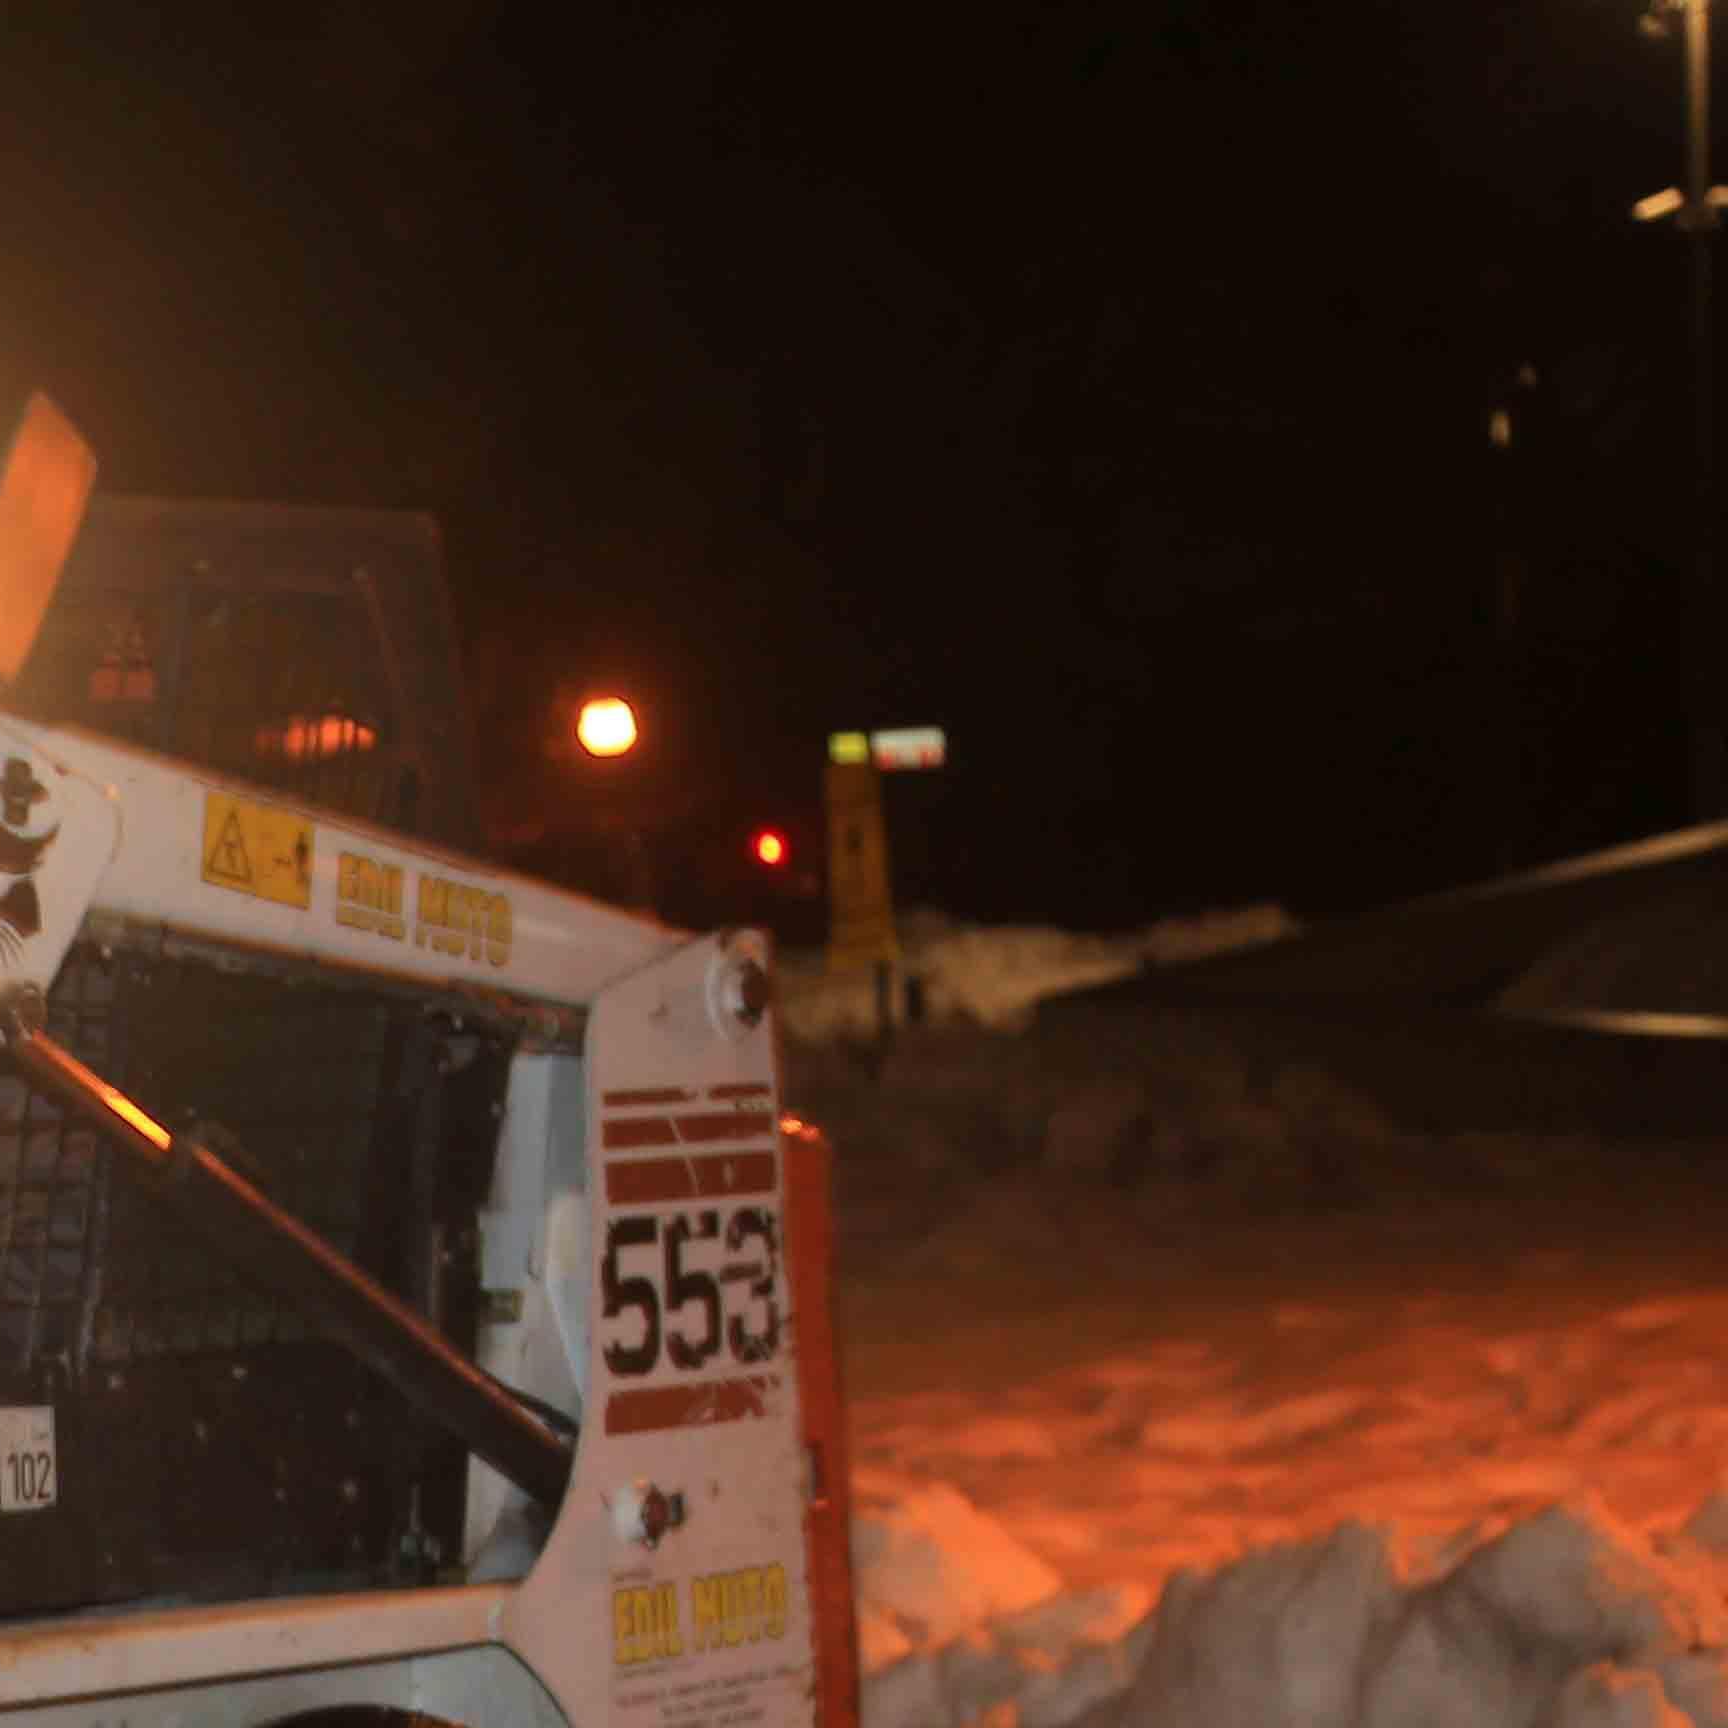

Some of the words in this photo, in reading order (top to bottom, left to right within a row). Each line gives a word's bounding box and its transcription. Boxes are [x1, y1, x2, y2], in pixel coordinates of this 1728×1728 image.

[600, 1206, 782, 1378] 553
[7, 1451, 51, 1501] 102
[613, 1582, 682, 1664] EDIL
